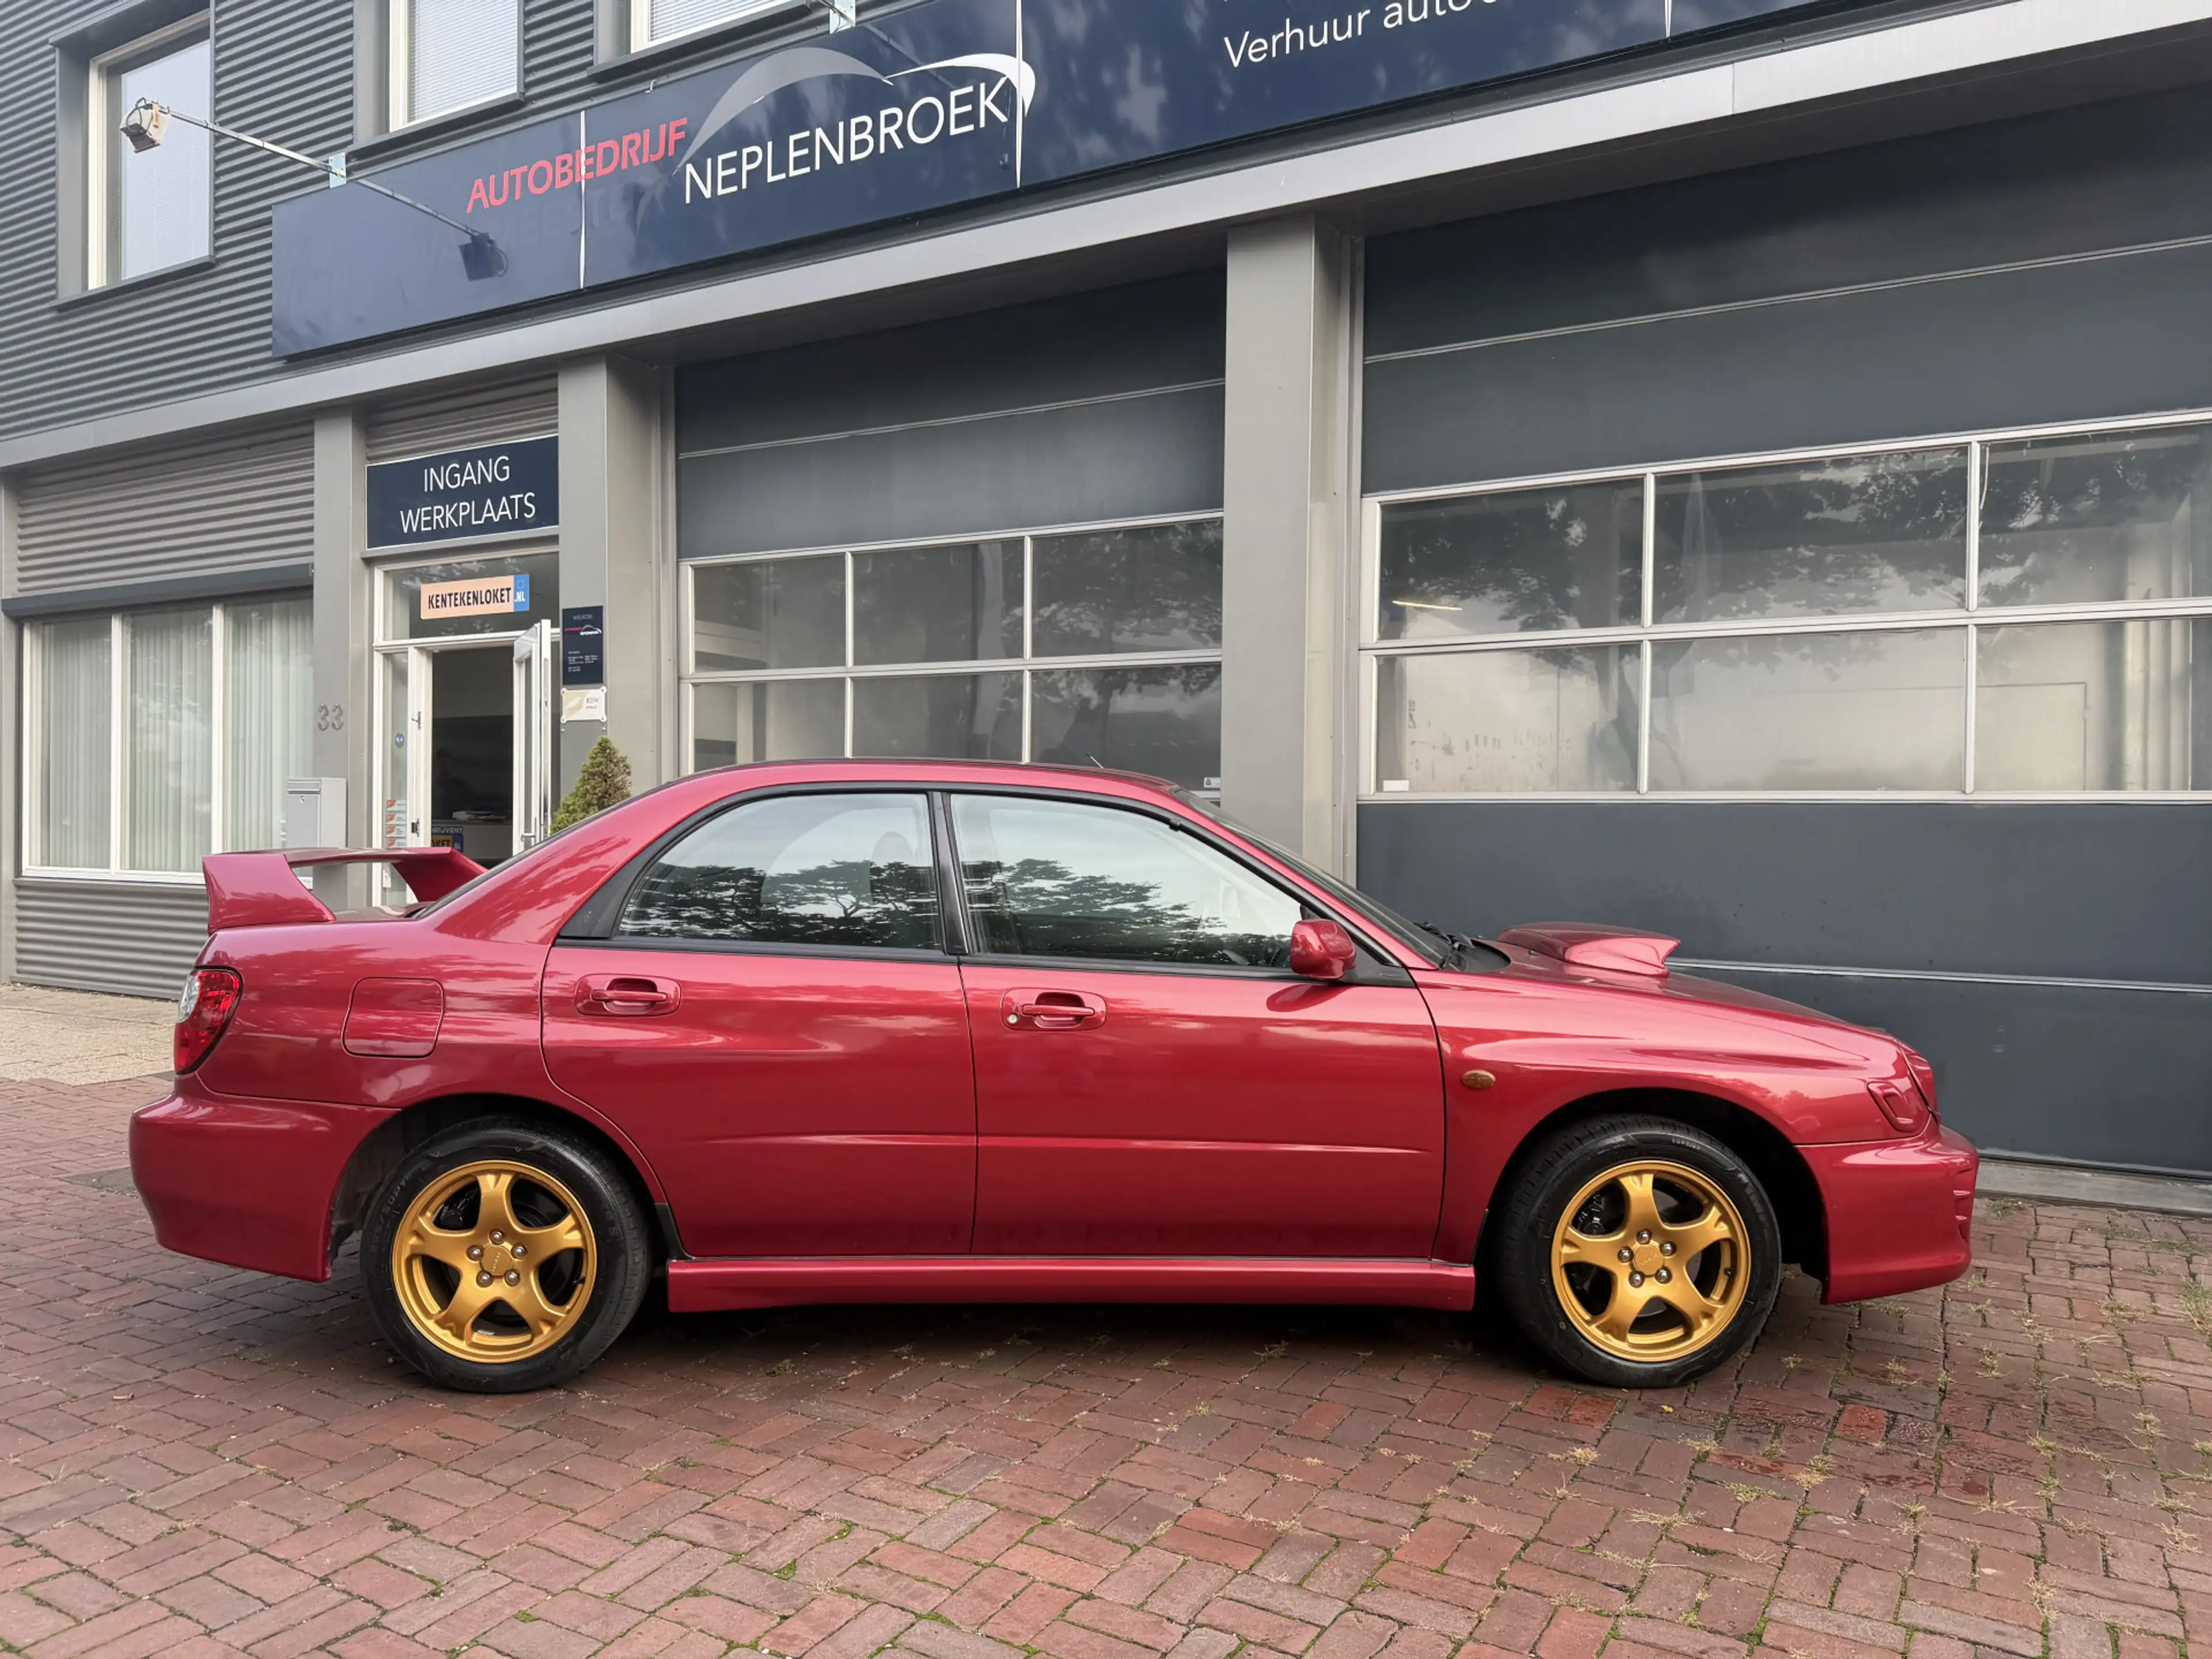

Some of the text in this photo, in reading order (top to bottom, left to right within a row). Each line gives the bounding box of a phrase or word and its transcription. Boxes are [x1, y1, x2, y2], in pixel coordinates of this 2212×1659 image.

[1224, 9, 1371, 68] Verhuur
[685, 75, 1009, 204] NEPLENBROEK
[466, 118, 688, 213] AUTOBEDRIJF
[423, 455, 510, 493] INGANG
[400, 492, 536, 533] WERKPLAATS
[428, 587, 512, 609] KENTEKENLOKET
[317, 703, 344, 731] 33
